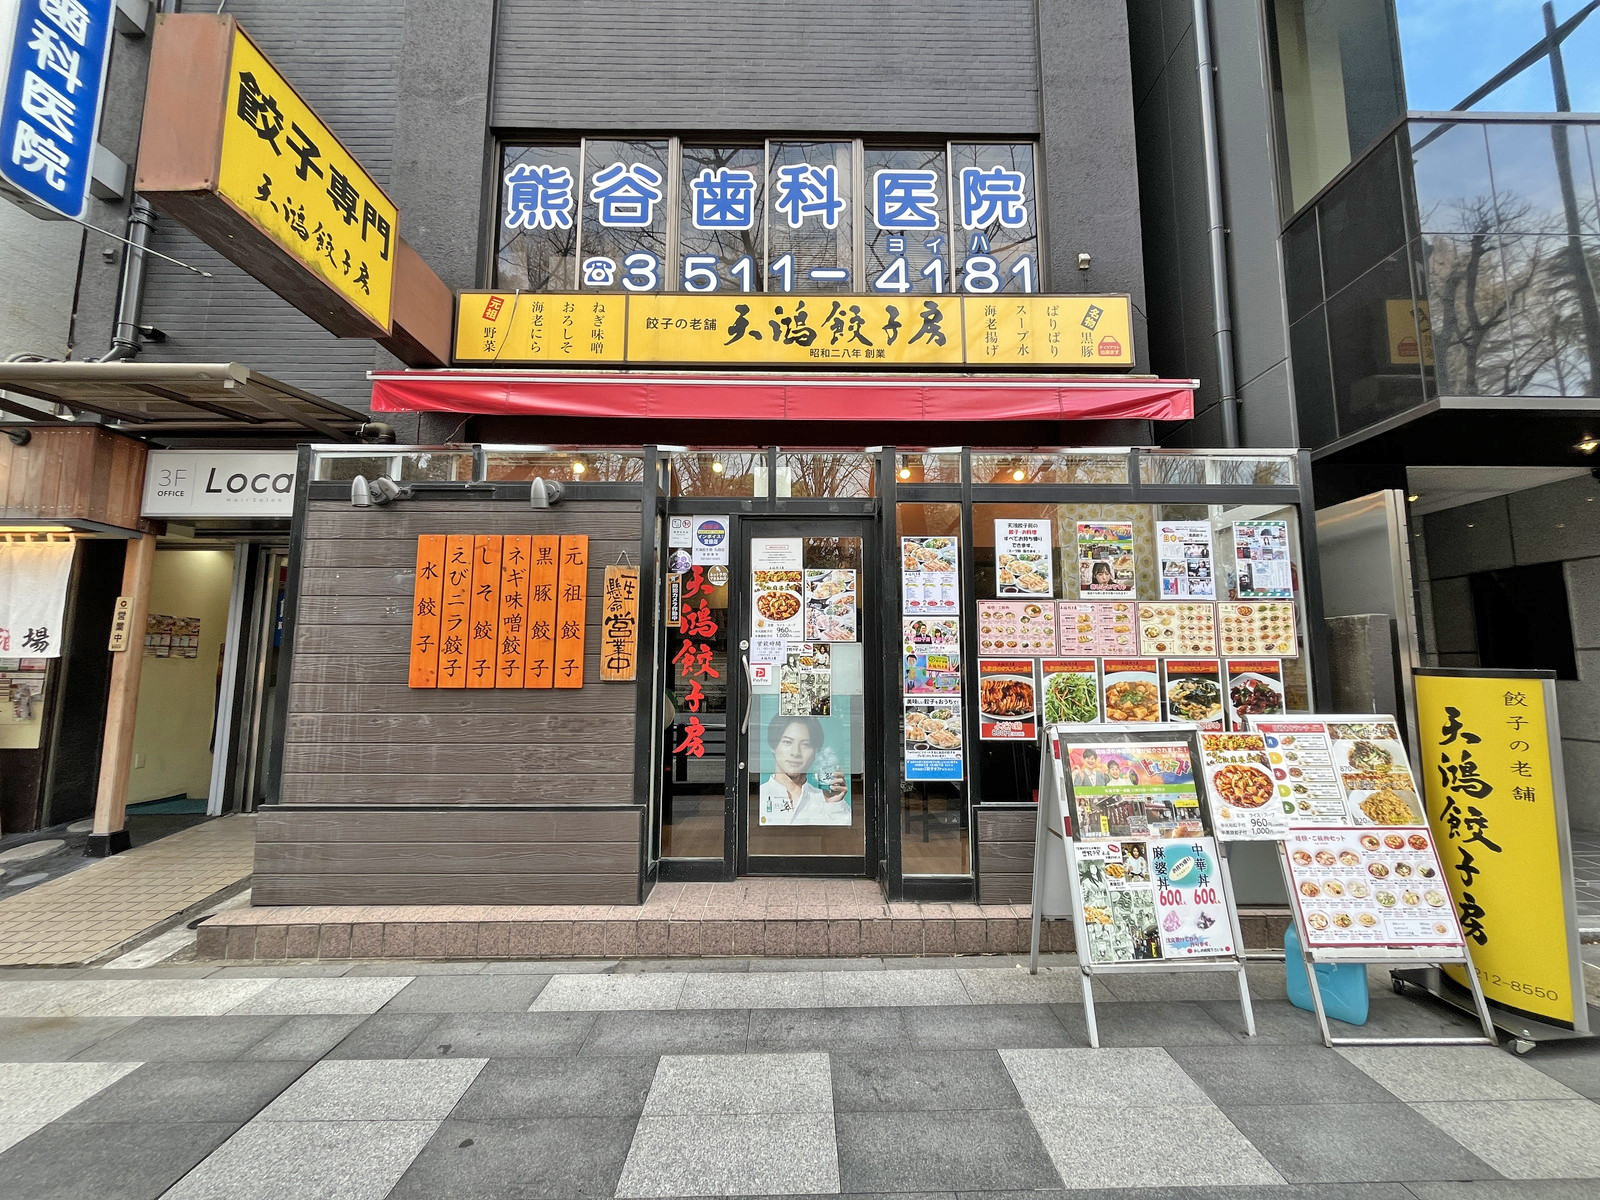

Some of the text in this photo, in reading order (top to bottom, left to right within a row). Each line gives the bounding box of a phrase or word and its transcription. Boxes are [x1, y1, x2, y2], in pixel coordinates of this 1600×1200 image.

[238, 70, 392, 262] 餃子専門
[504, 164, 1027, 231] 熊谷歯科医院
[254, 173, 370, 295] 天鴻餃子房
[483, 297, 503, 320] 元祖
[530, 301, 545, 353] 海老にら
[560, 301, 575, 353] おろしそ
[590, 301, 605, 354] ねぎ味噌
[645, 316, 717, 331] 餃子の老舗
[724, 300, 947, 347] 天鴻餃子房
[984, 304, 999, 356] 海老揚げ
[1016, 304, 1030, 355] スープ水
[1046, 305, 1061, 357] ぱりぱり
[1083, 307, 1102, 328] 名物
[483, 327, 496, 352] 野菜
[809, 348, 886, 358] 昭和二八年 創業
[1080, 331, 1095, 358] 黒豚
[159, 468, 188, 487] 3F
[416, 561, 439, 654] 水餃子
[443, 547, 469, 678] えびニラ餃子
[471, 546, 494, 678] しそ餃子
[500, 547, 525, 678] ネギ味噌餃子
[530, 547, 554, 678] 黒豚餃子
[560, 547, 584, 678] 元祖餃子
[604, 612, 635, 674] 営業中
[672, 566, 720, 758] 天鴻餃子房
[1503, 690, 1535, 803] 餃子の老舗
[1439, 706, 1502, 946] 天鴻餃子房
[1152, 845, 1170, 891] 麻婆丼
[1191, 843, 1210, 888] 中華丼
